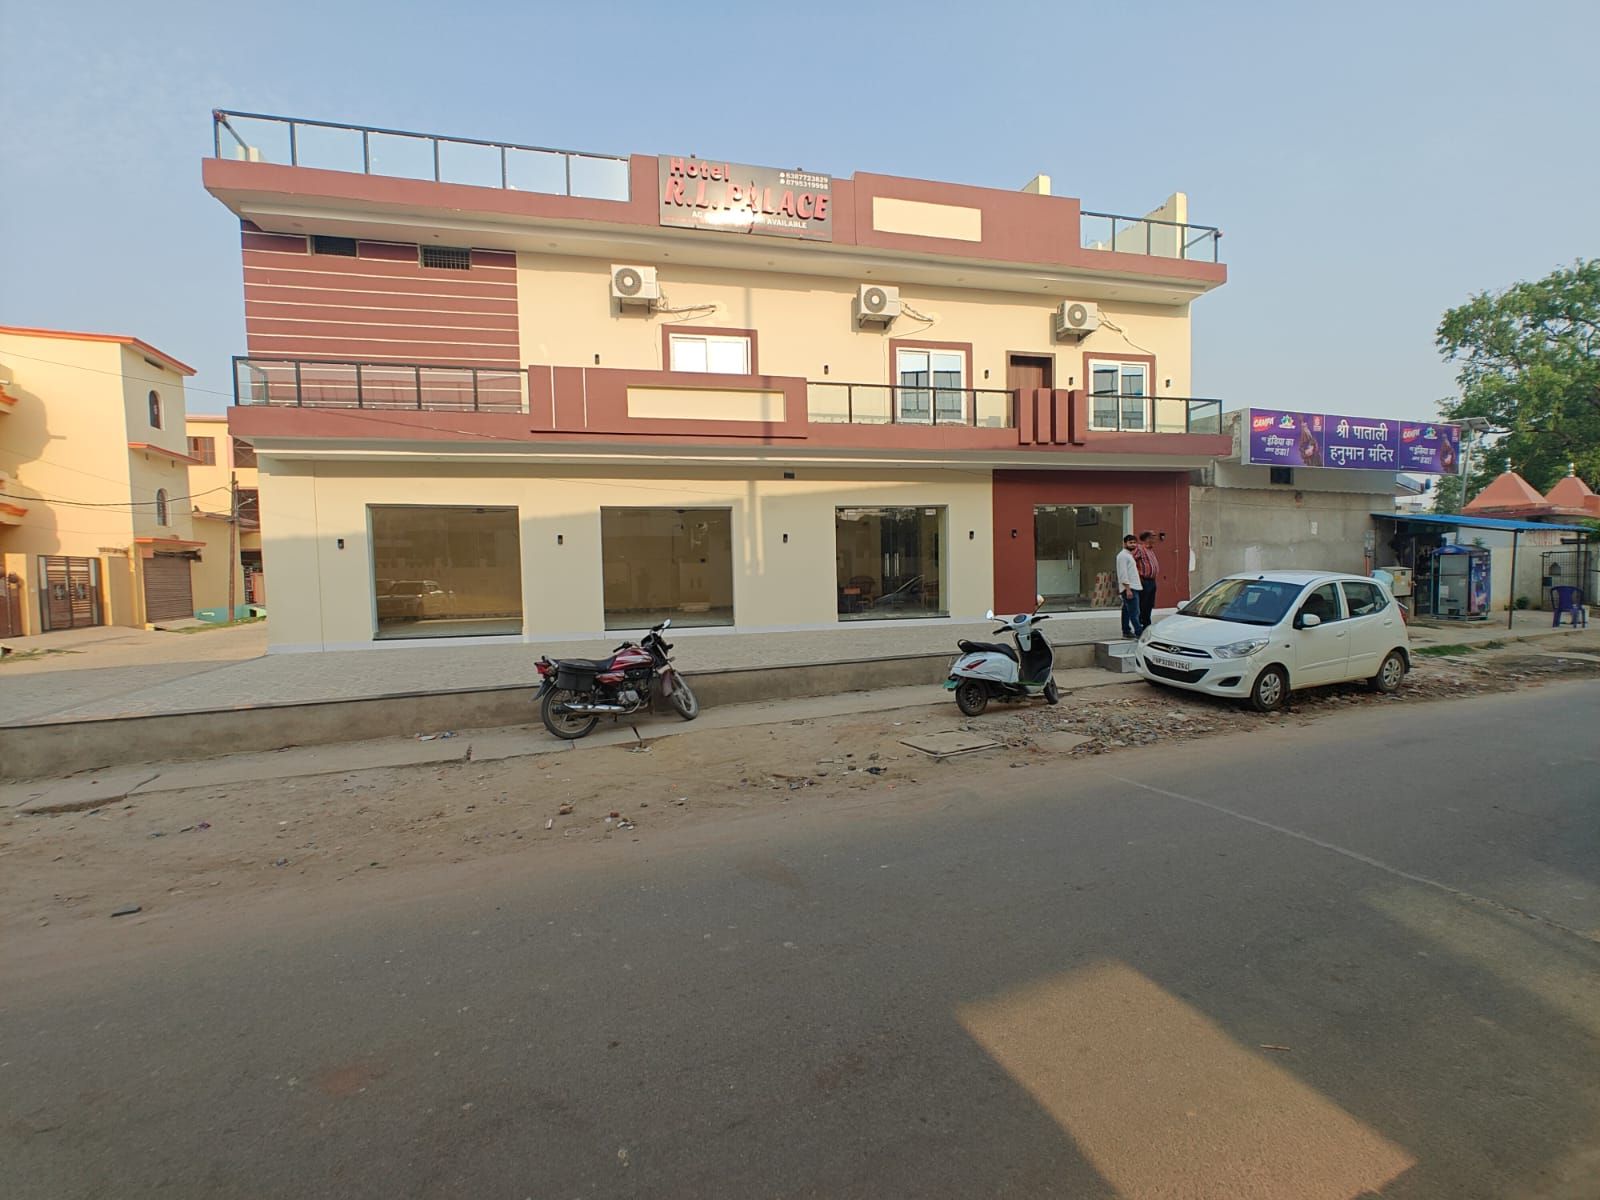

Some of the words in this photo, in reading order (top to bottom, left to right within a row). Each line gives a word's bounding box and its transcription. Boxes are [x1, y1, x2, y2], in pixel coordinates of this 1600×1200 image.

[670, 157, 730, 182] Hotel
[723, 183, 831, 221] PALACE
[767, 218, 807, 229] AVAILABLE
[1336, 419, 1350, 438] श्री
[1352, 422, 1389, 441] पाताली
[1329, 445, 1365, 466] हनुमान
[1367, 443, 1394, 463] मंदिर
